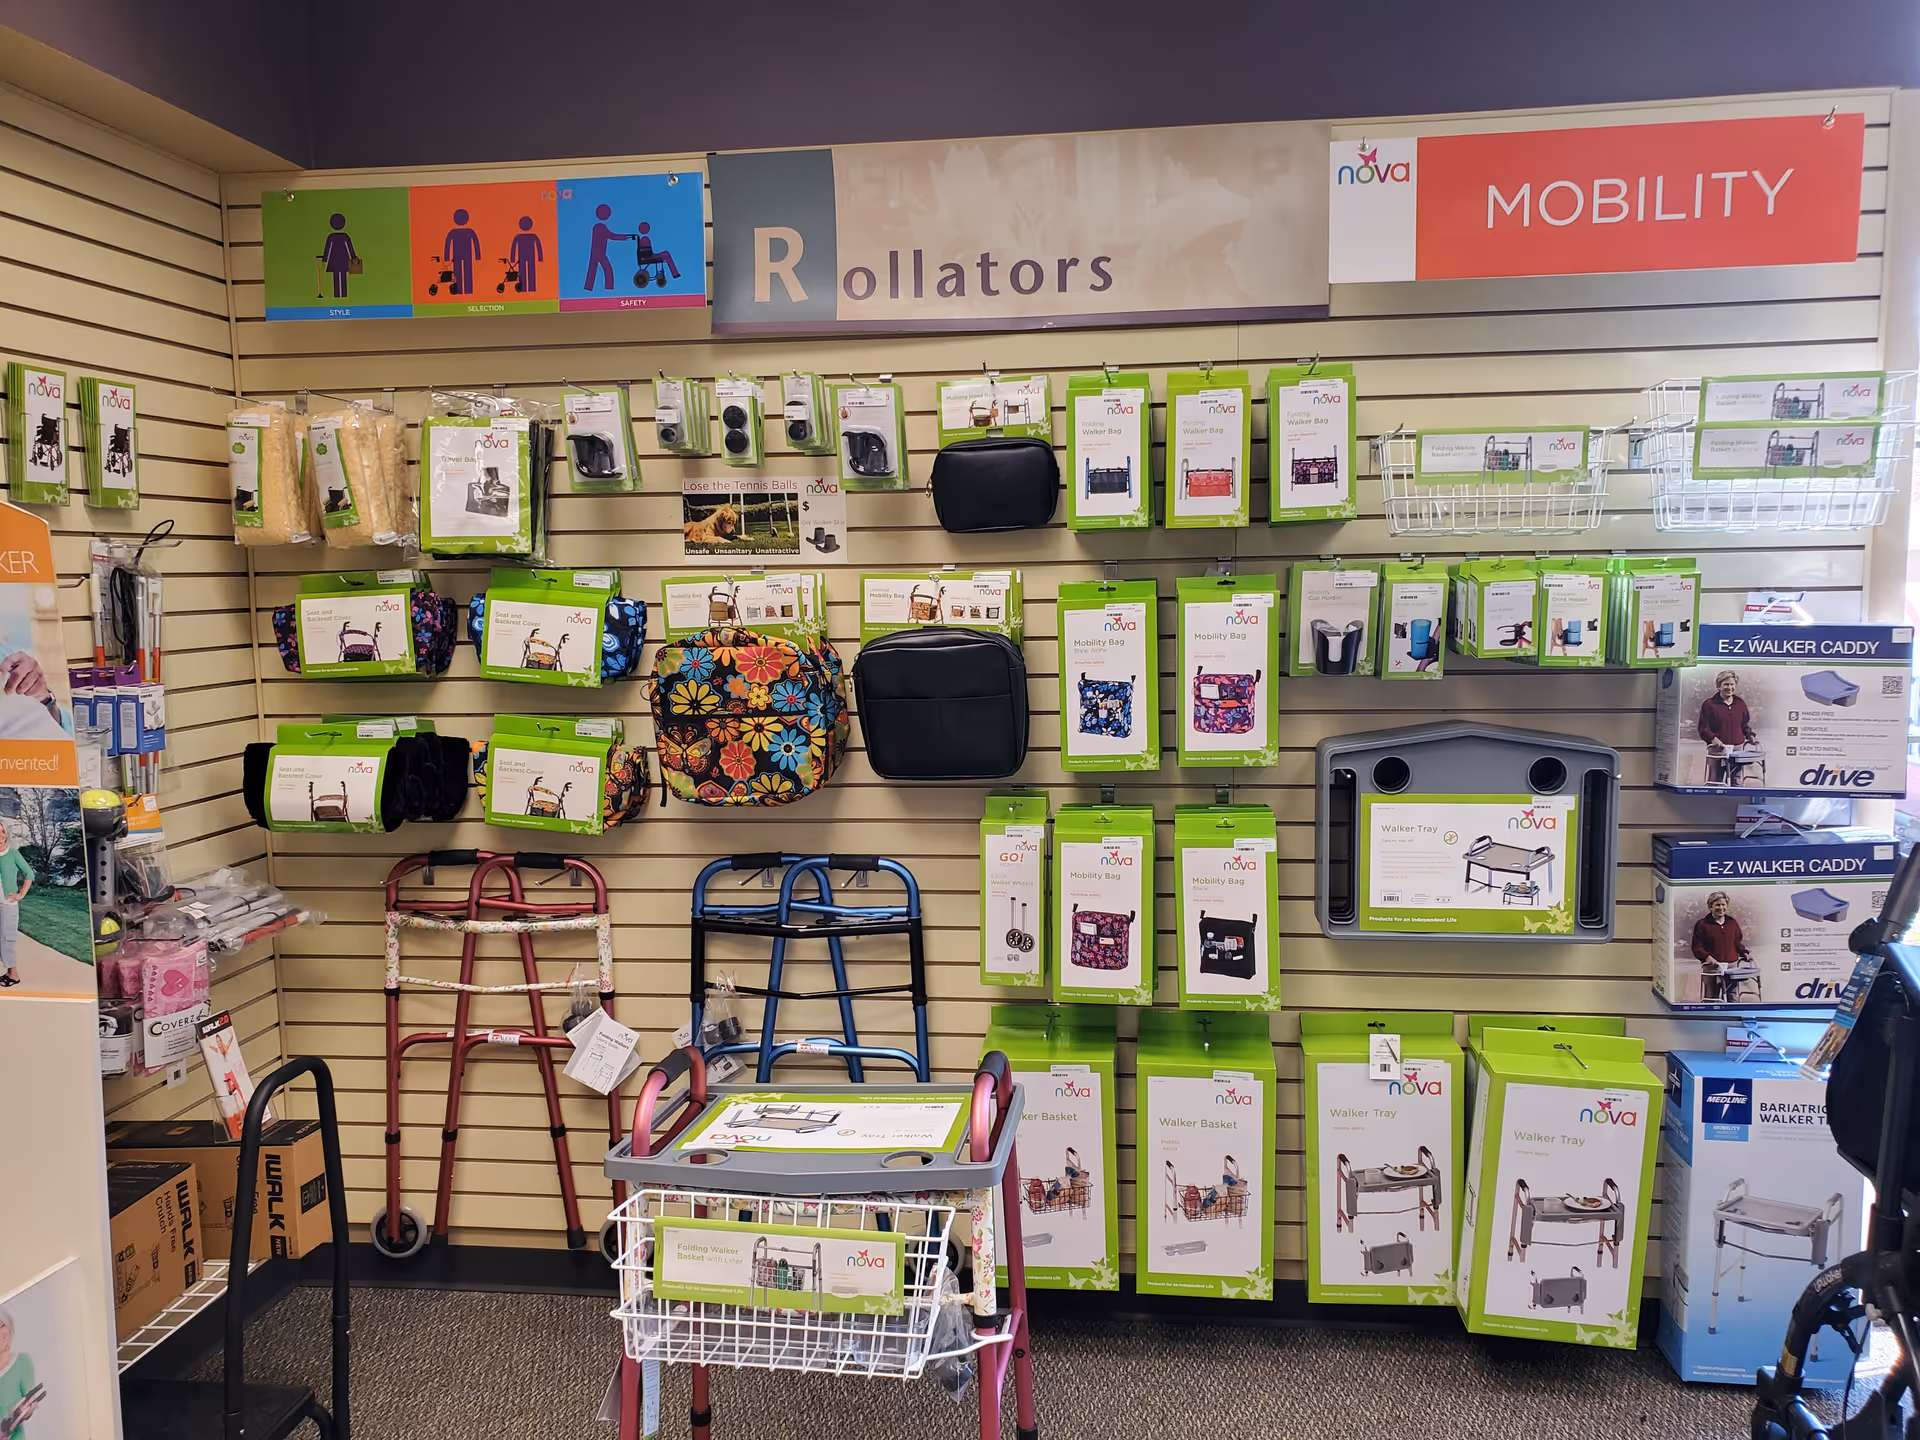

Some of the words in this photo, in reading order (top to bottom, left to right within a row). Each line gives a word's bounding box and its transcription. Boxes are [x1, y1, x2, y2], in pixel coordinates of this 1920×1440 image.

[1337, 161, 1410, 184] nova
[541, 187, 572, 200] nova
[1486, 169, 1795, 229] MOBILITY
[620, 299, 646, 307] SAFETY
[329, 308, 350, 316] STYLE
[467, 304, 505, 313] SELECTION
[28, 382, 61, 400] nova
[1843, 388, 1870, 397] nova
[102, 393, 130, 410] nova
[1313, 395, 1341, 404] nova
[1107, 406, 1133, 415] nova
[1209, 405, 1236, 414] nova
[1287, 418, 1312, 426] Walker
[1314, 417, 1328, 425] Bag
[475, 438, 509, 449] nova
[1549, 441, 1575, 450] nova
[1836, 436, 1864, 446] nova
[683, 481, 709, 490] Lose
[712, 481, 730, 490] the
[735, 480, 768, 490] Tennis
[772, 480, 798, 490] Balls
[806, 482, 838, 493] nova
[802, 501, 809, 512] $
[376, 604, 399, 612] nova
[567, 616, 591, 624] nova
[1226, 615, 1258, 625] nova
[1104, 621, 1136, 631] nova
[1230, 632, 1246, 640] Bag
[1074, 639, 1106, 647] Mobility
[1109, 638, 1125, 647] Bag
[1718, 640, 1744, 653] E-Z
[1749, 641, 1816, 654] WALKER
[1821, 641, 1879, 654] CADDY
[348, 765, 373, 774] nova
[569, 765, 593, 773] nova
[1800, 764, 1874, 787] drive
[1508, 816, 1556, 830] nova
[1381, 825, 1414, 833] Walker
[1417, 825, 1438, 834] Tray
[1000, 853, 1024, 862] GO!
[1101, 856, 1132, 866] nova
[1224, 861, 1256, 870] nova
[1708, 862, 1733, 875] E-Z
[1737, 860, 1805, 873] WALKER
[1809, 858, 1866, 872] CADDY
[1070, 872, 1102, 880] Mobility
[1105, 872, 1120, 880] Bag
[599, 1032, 613, 1041] Folding
[614, 1039, 629, 1049] Walkers
[1055, 1087, 1090, 1097] nova
[1389, 1082, 1441, 1095] nova
[1215, 1094, 1252, 1105] nova
[1706, 1096, 1748, 1104] MEDLINE
[1041, 1112, 1077, 1121] Basket
[1330, 1109, 1369, 1118] Walker
[1373, 1109, 1397, 1119] Tray
[1580, 1108, 1637, 1126] nova
[1759, 1114, 1813, 1124] WALKER
[1159, 1118, 1197, 1128] Walker
[1200, 1119, 1237, 1130] Basket
[709, 1134, 771, 1142] nova
[1514, 1131, 1556, 1143] Walker
[1561, 1135, 1585, 1147] Tray
[164, 1191, 174, 1227] Hands
[156, 1197, 166, 1234] Crutch
[168, 1226, 176, 1252] Free
[677, 1244, 707, 1254] Folding
[710, 1245, 739, 1255] Walker
[677, 1253, 704, 1262] Basket
[706, 1255, 722, 1263] with
[724, 1257, 743, 1265] Liner
[847, 1255, 885, 1268] nova
